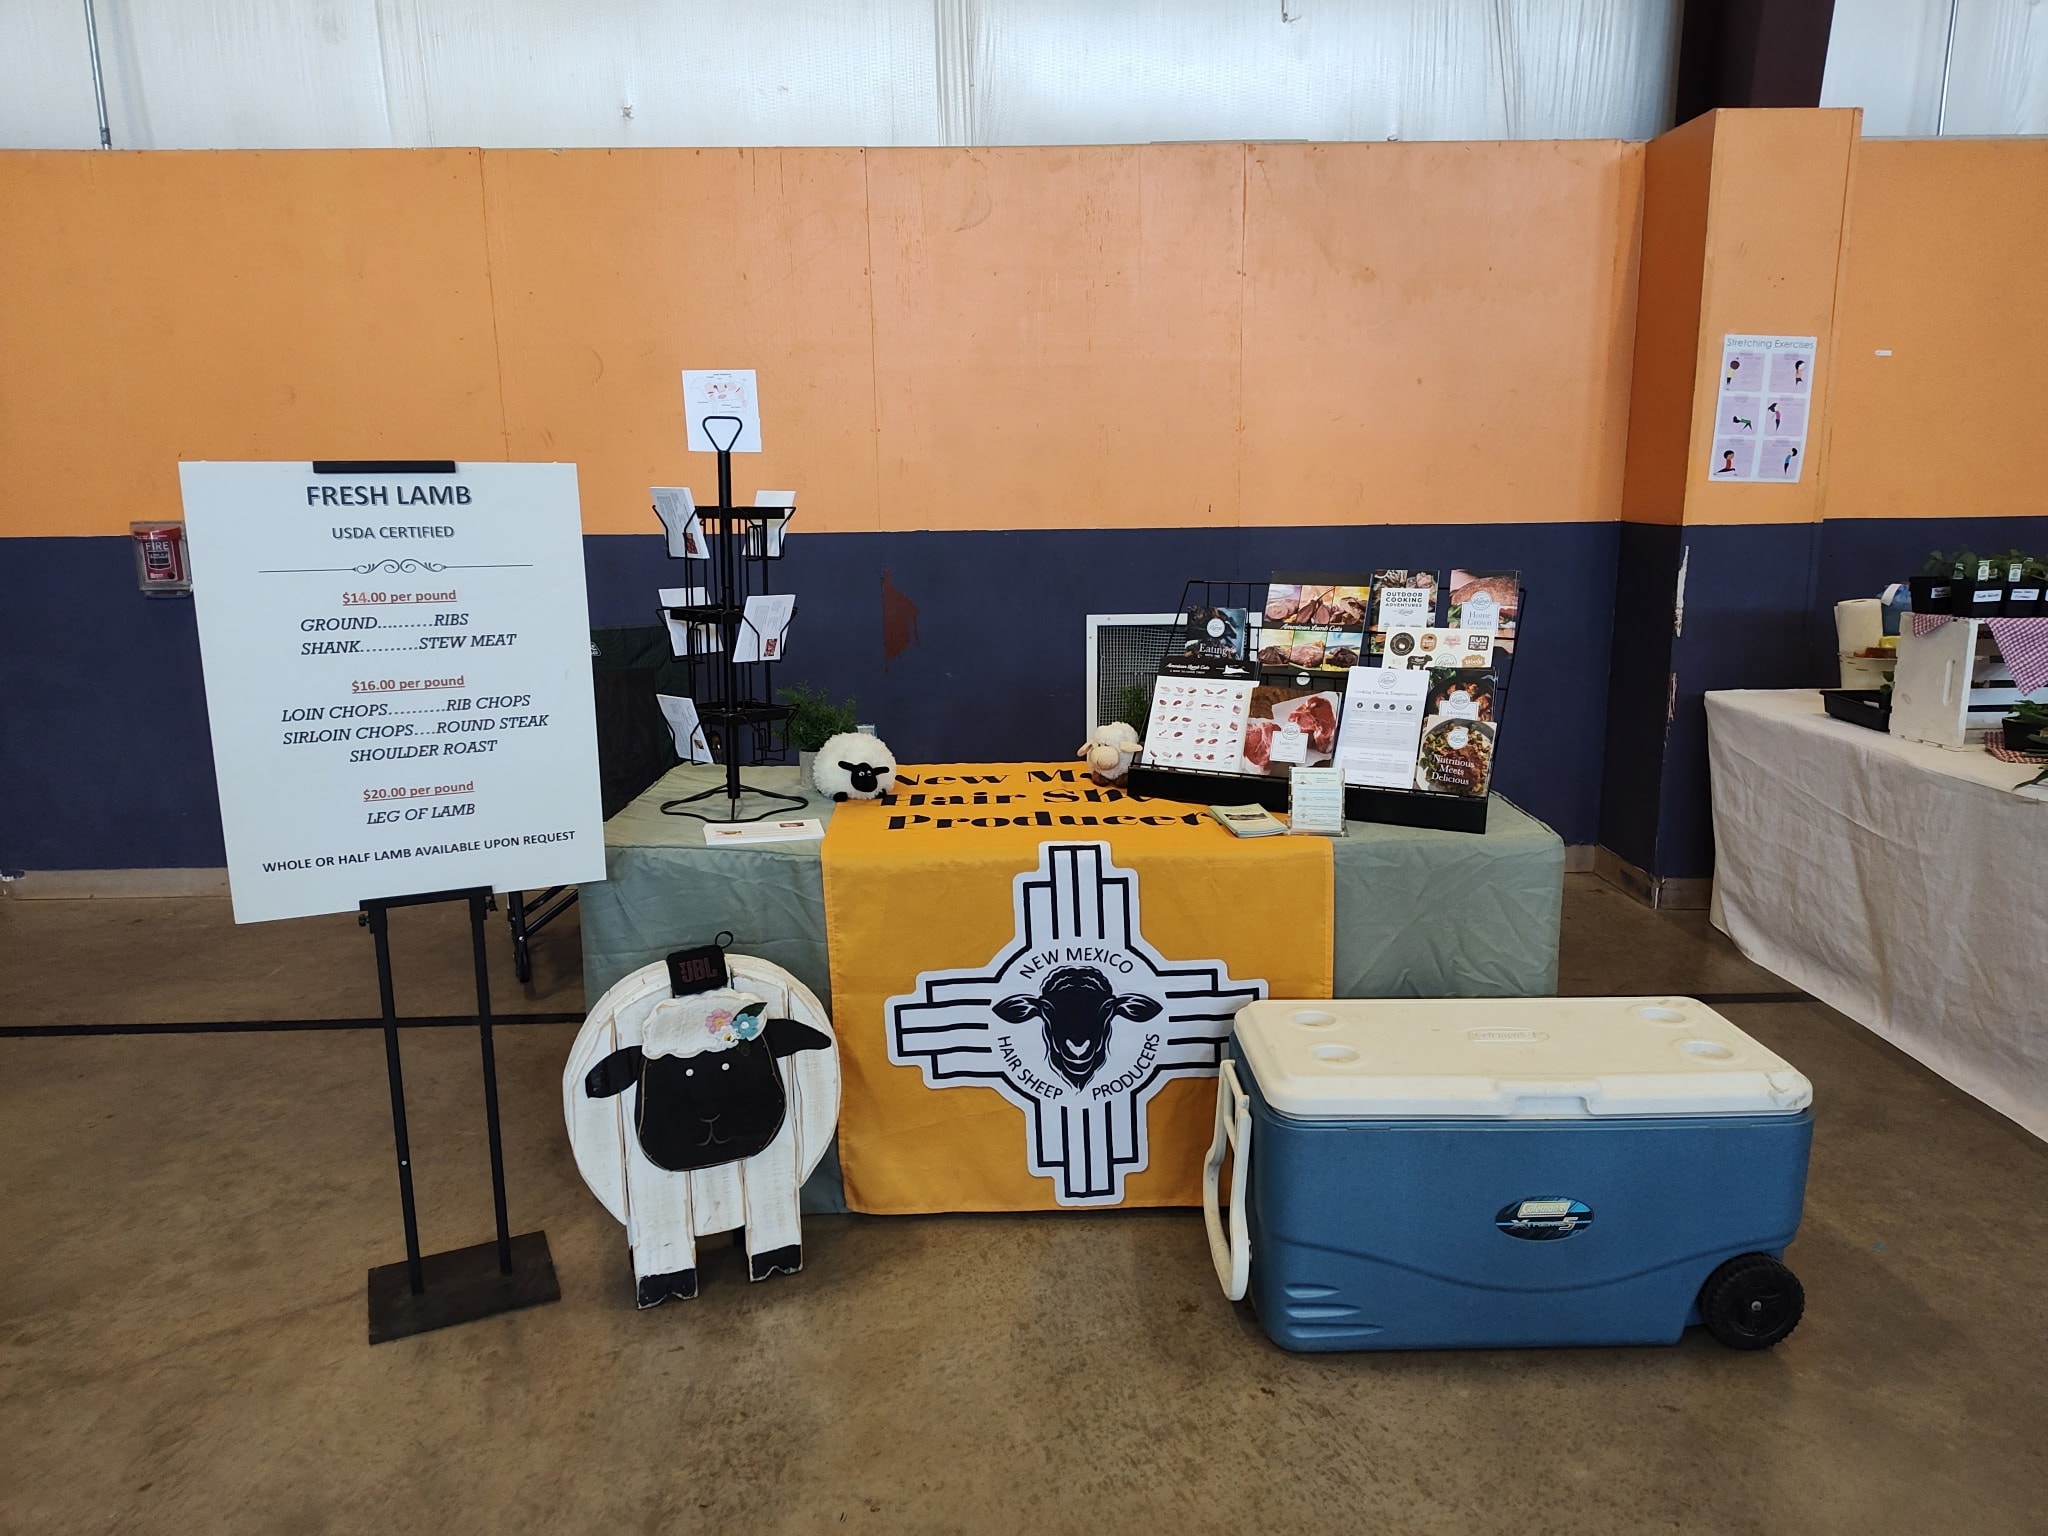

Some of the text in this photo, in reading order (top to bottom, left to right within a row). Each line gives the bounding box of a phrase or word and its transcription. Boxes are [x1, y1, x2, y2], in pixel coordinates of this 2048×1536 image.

[1727, 338, 1814, 350] Stretching Exercises
[306, 485, 472, 506] FRESH LAMB
[332, 525, 455, 540] USDA CERTIFIED
[145, 541, 169, 551] FIRE
[342, 589, 457, 605] $14.00 per pound
[1467, 619, 1492, 627] Grown
[1469, 611, 1491, 619] Home
[1280, 622, 1310, 630] American
[470, 633, 517, 648] MEAT
[1199, 643, 1228, 657] Eating
[351, 675, 465, 693] $16.00 per pound
[281, 708, 324, 722] LOIN
[475, 694, 531, 710] CHOPS
[283, 728, 351, 745] SIRLOIN
[499, 714, 549, 730] STEAK
[350, 739, 498, 763] SHOULDER ROAST
[1432, 752, 1475, 768] Nutritious
[1431, 771, 1469, 785] Delicious
[1439, 764, 1465, 776] Meets
[895, 774, 1010, 786] New
[363, 780, 475, 801] $20.00 per pound
[880, 791, 1026, 807] Hair
[367, 803, 476, 825] LEG OF LAMB
[262, 830, 575, 873] WHOLE OR HALF LAMB AVAILABLE UPON REQUEST
[678, 957, 718, 983] JBL
[1019, 947, 1134, 979] NEW MEXICO
[997, 1033, 1160, 1100] HAIR SHEEP PRODUCERS
